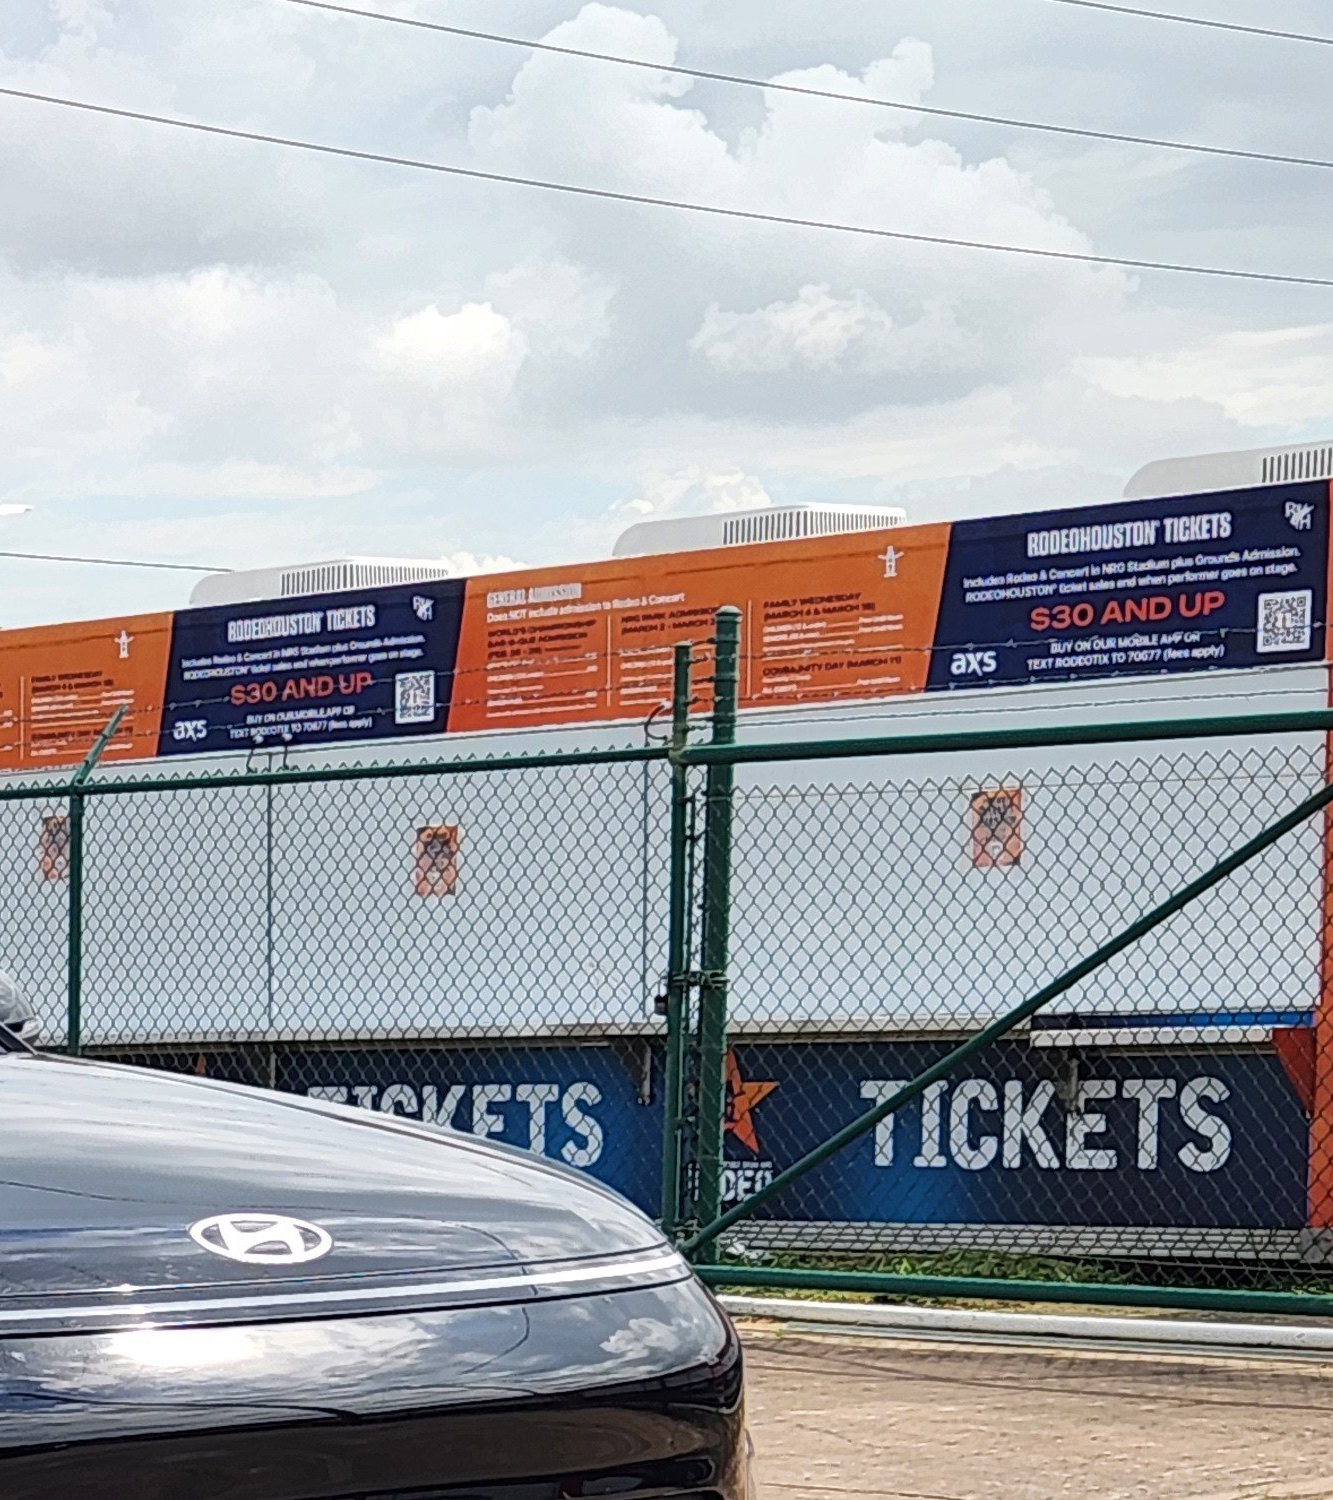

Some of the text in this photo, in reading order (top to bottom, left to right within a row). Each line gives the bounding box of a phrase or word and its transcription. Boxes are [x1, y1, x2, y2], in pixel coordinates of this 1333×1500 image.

[1027, 512, 1232, 557] RODEOHOUSTON TICKETS
[1049, 566, 1090, 579] Concert
[1102, 561, 1125, 574] NRG
[1127, 559, 1170, 572] Stadium
[1171, 556, 1193, 570] plus
[1195, 551, 1240, 565] Grounds
[1168, 570, 1219, 586] performer
[228, 605, 375, 643] RODEOHOUSTON TICKETS
[1030, 591, 1225, 631] $30 AND UP
[1050, 640, 1074, 654] BUY
[1093, 638, 1116, 650] OUR
[951, 650, 997, 676] axs
[1027, 657, 1054, 671] TEXT
[1111, 652, 1126, 663] TO
[281, 675, 333, 701] AND
[338, 671, 372, 695] UP
[860, 1077, 1232, 1173] TICKETS
